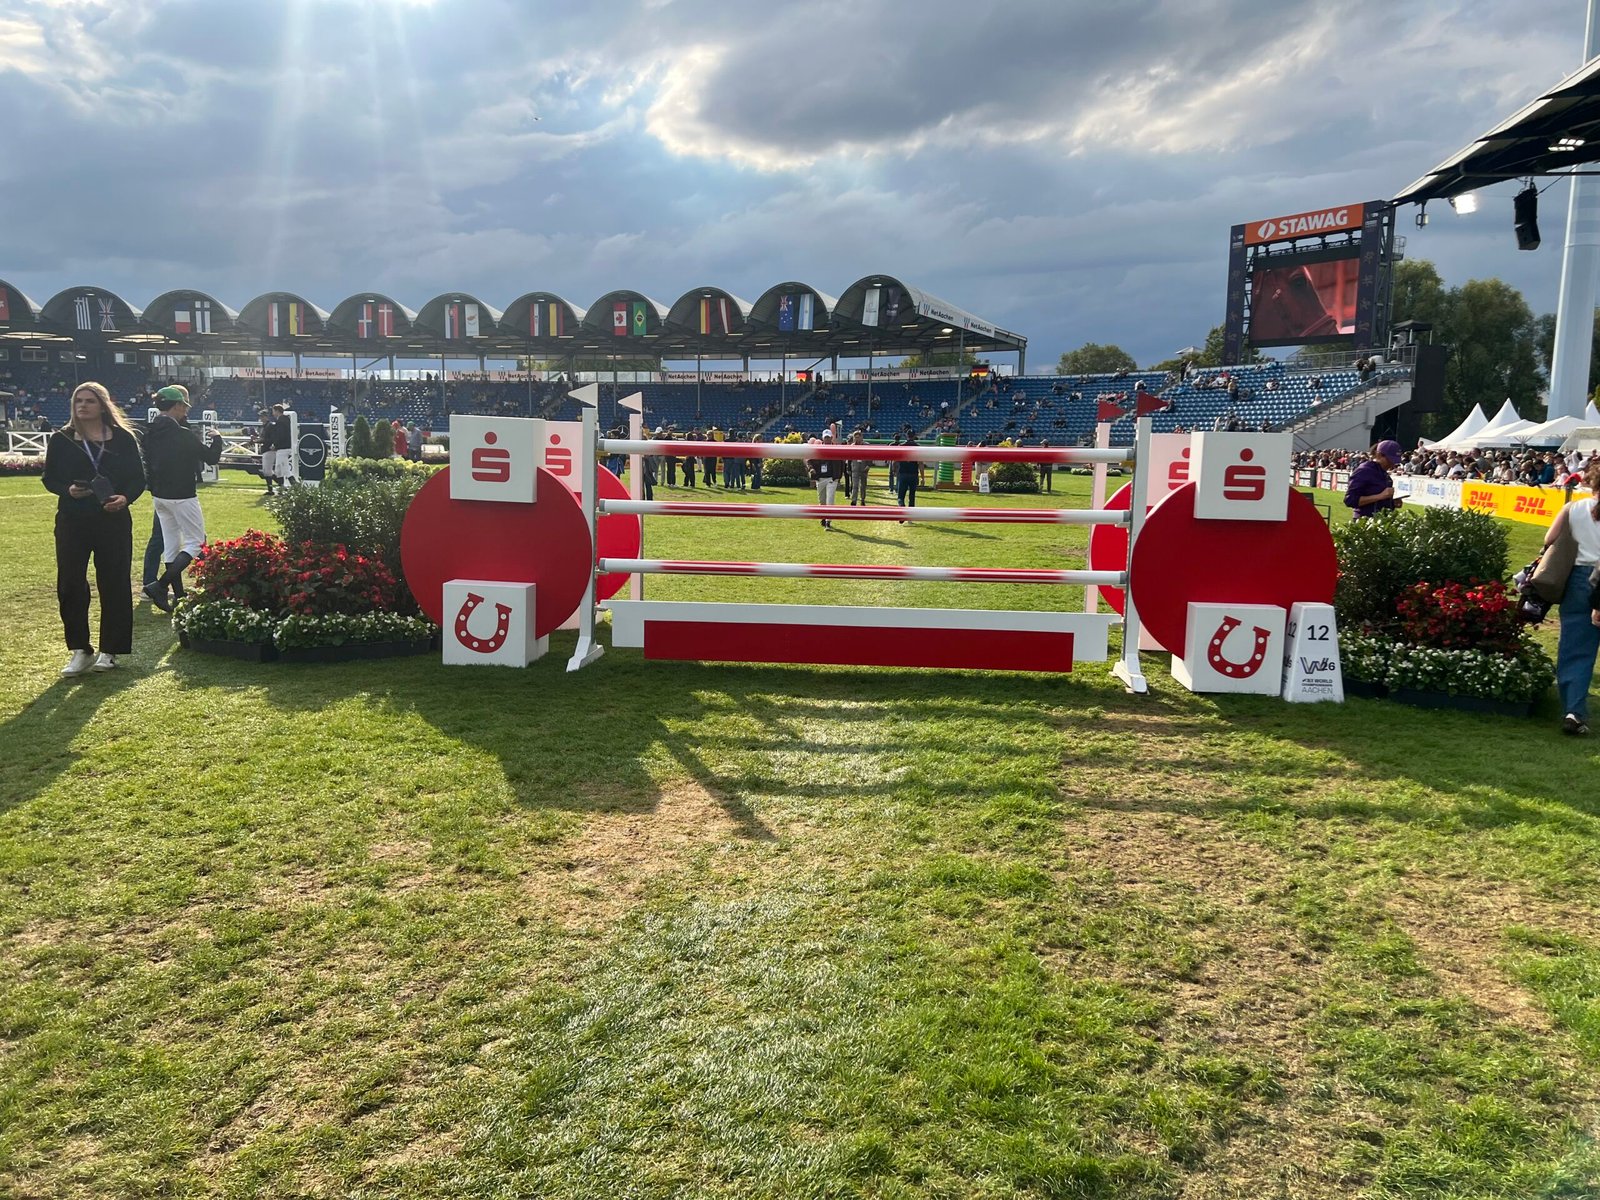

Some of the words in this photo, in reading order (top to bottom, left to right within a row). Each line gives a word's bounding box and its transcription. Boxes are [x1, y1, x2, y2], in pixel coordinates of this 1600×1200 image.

[1279, 209, 1348, 236] STAWAG
[930, 309, 954, 321] NetAachen
[970, 322, 992, 334] NetAachen
[1469, 490, 1496, 508] DHL
[1514, 495, 1549, 516] DHL
[1307, 624, 1330, 641] 12
[1302, 686, 1333, 694] AACHEN
